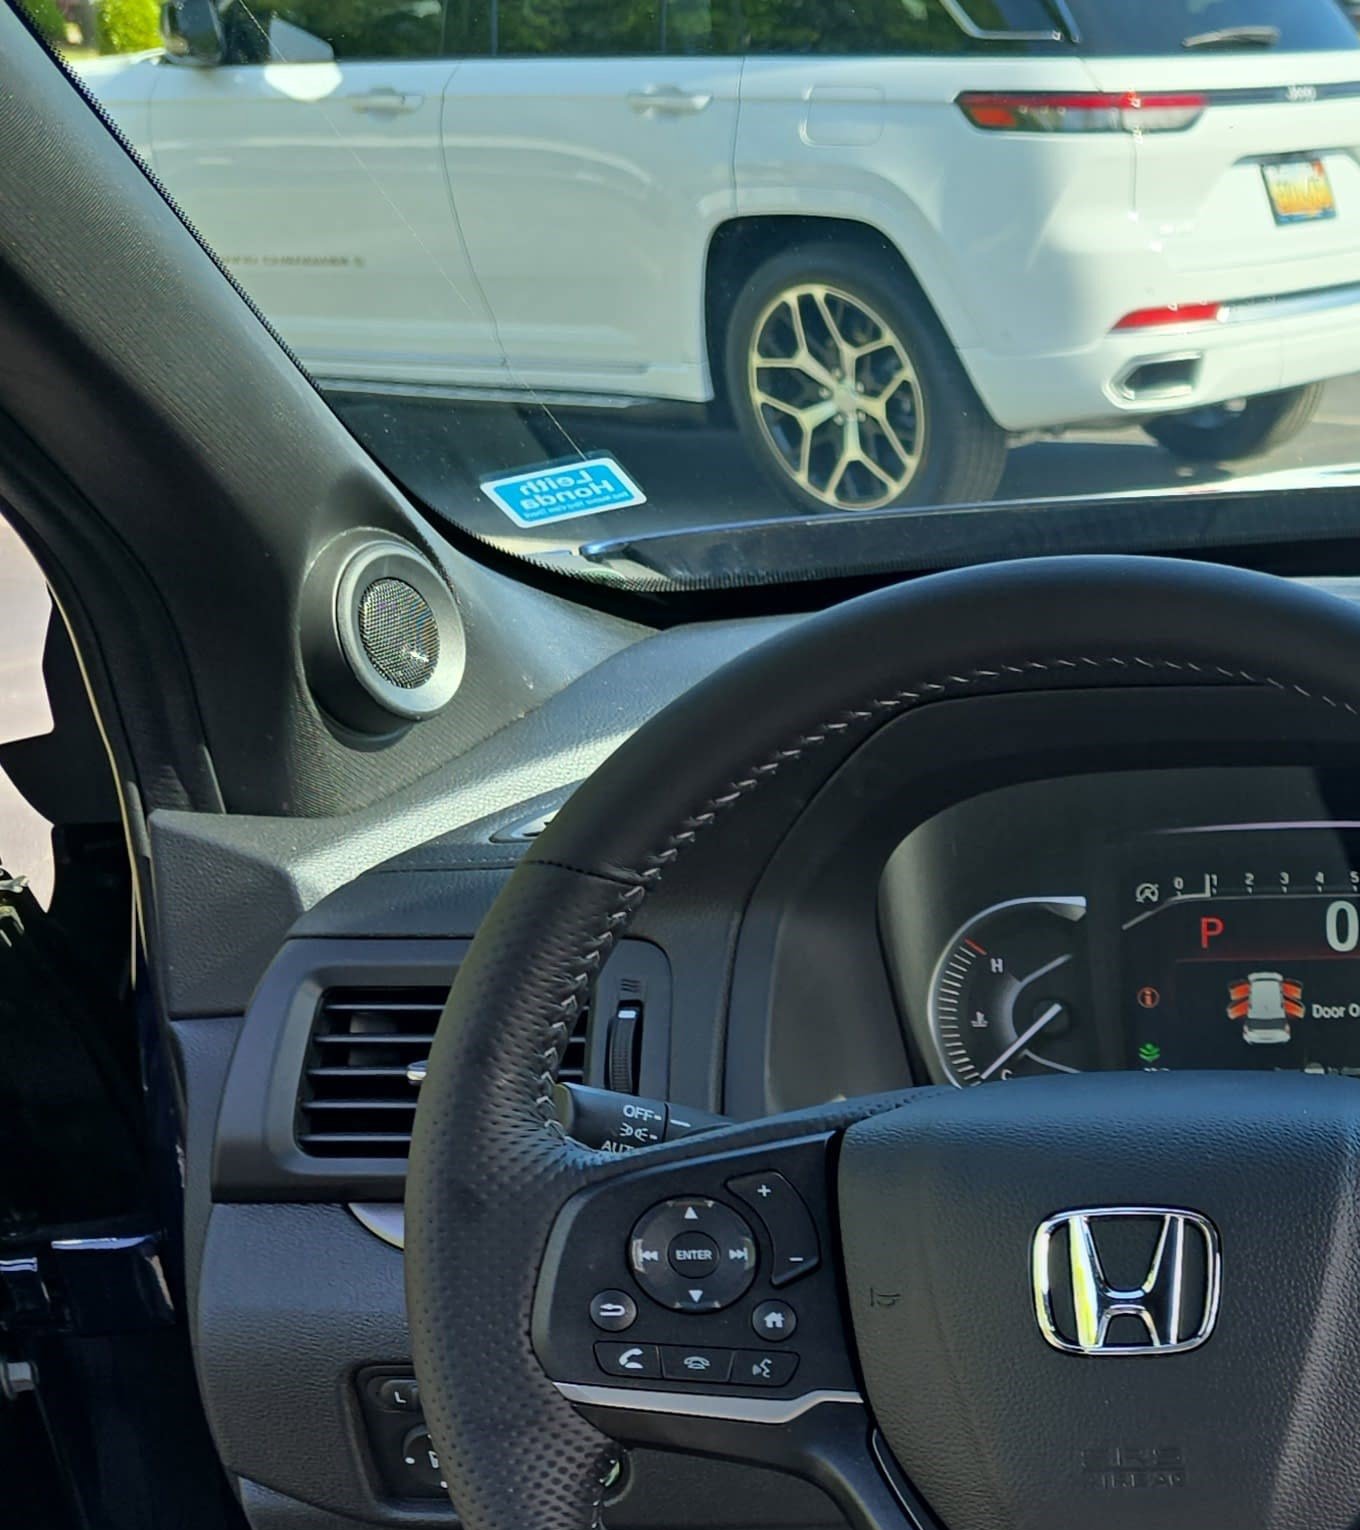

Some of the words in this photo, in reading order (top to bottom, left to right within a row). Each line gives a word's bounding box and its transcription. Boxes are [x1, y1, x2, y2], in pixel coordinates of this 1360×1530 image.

[1174, 877, 1184, 889] 0
[1211, 874, 1218, 886] 1
[1245, 873, 1255, 884] 2
[1280, 872, 1289, 884] 3
[1315, 872, 1324, 883] 4
[1350, 872, 1360, 883] 5
[1201, 917, 1224, 948] P
[1325, 901, 1360, 952] 0
[990, 958, 1003, 973] H
[1312, 1004, 1345, 1018] Door
[623, 1104, 655, 1121] OFF
[601, 1140, 635, 1154] AUT
[675, 1249, 713, 1261] ENTER
